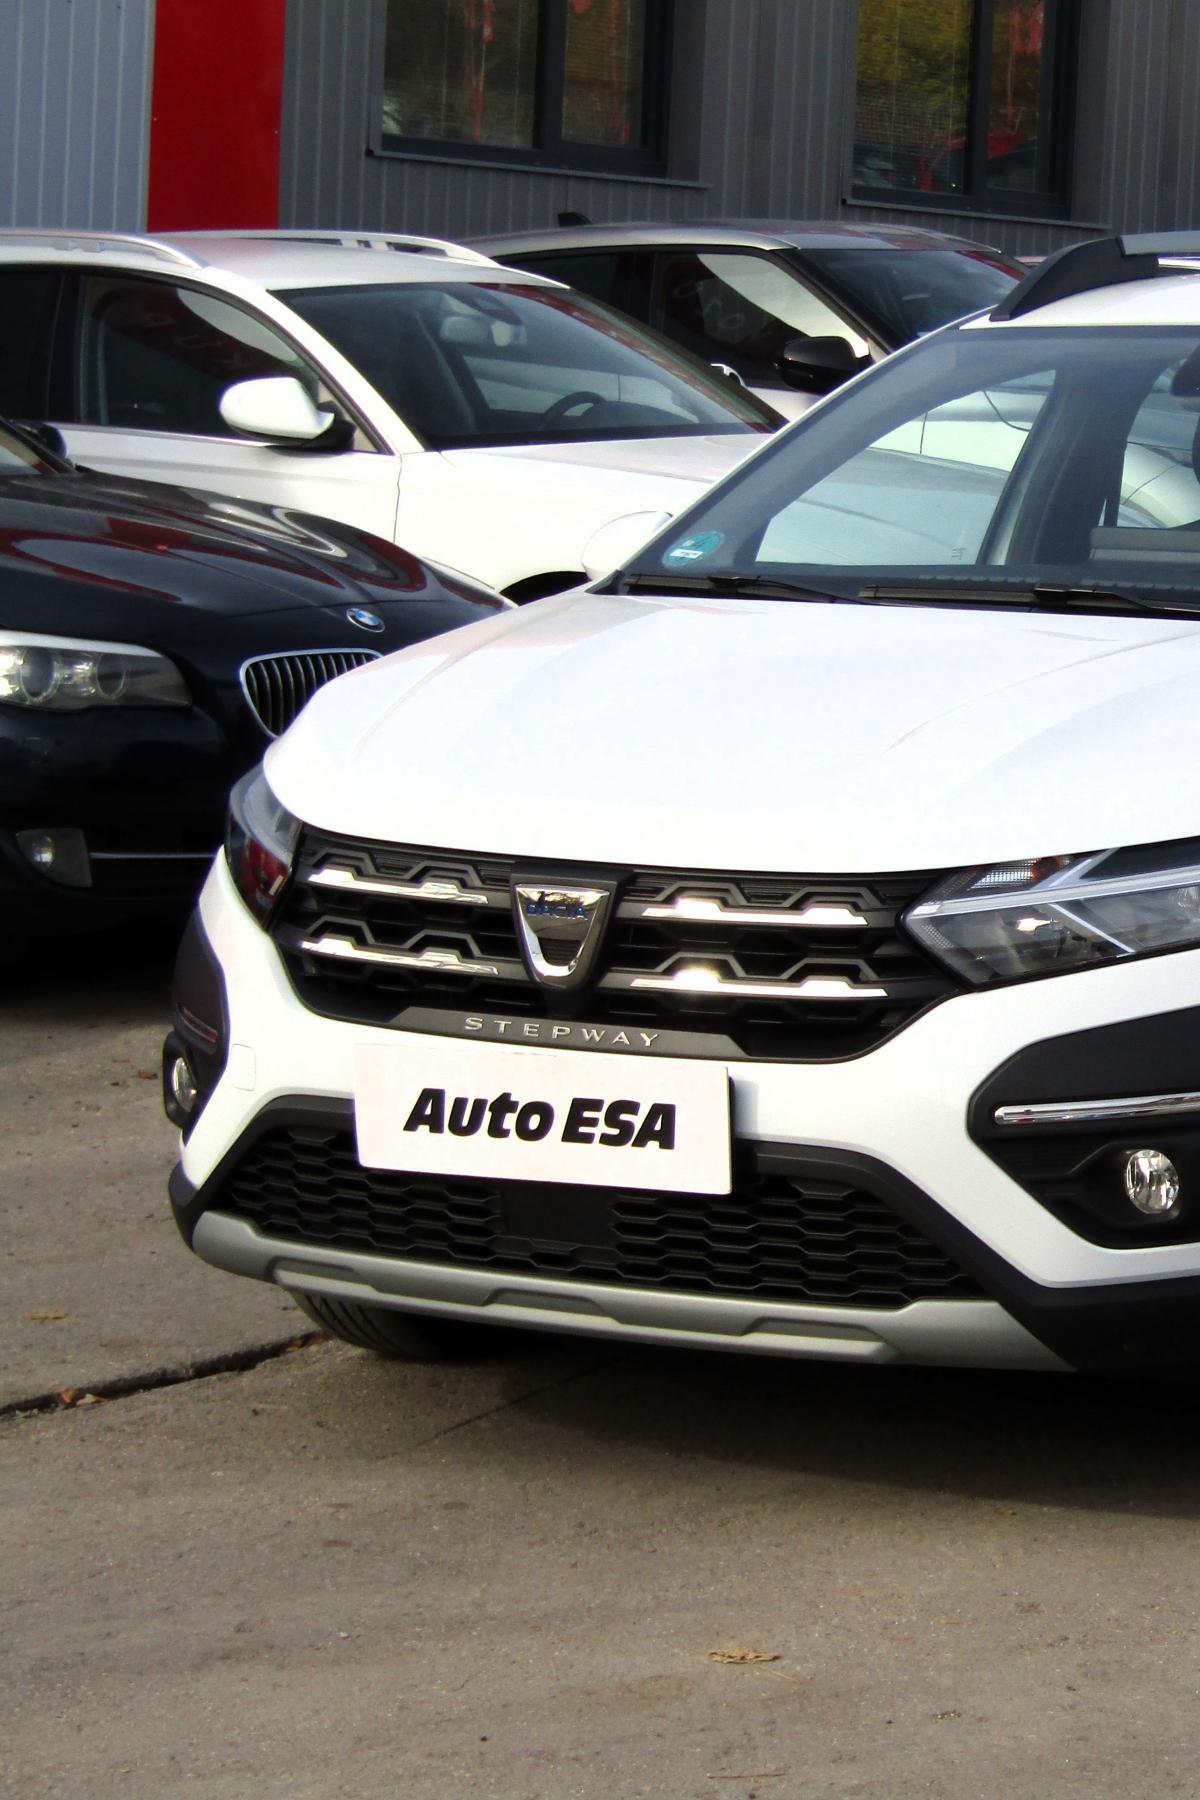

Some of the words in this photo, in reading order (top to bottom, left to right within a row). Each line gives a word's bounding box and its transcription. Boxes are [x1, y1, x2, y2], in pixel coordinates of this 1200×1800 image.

[463, 1016, 660, 1048] STEPWAY
[402, 1087, 556, 1142] Auto
[560, 1096, 677, 1151] ESA
